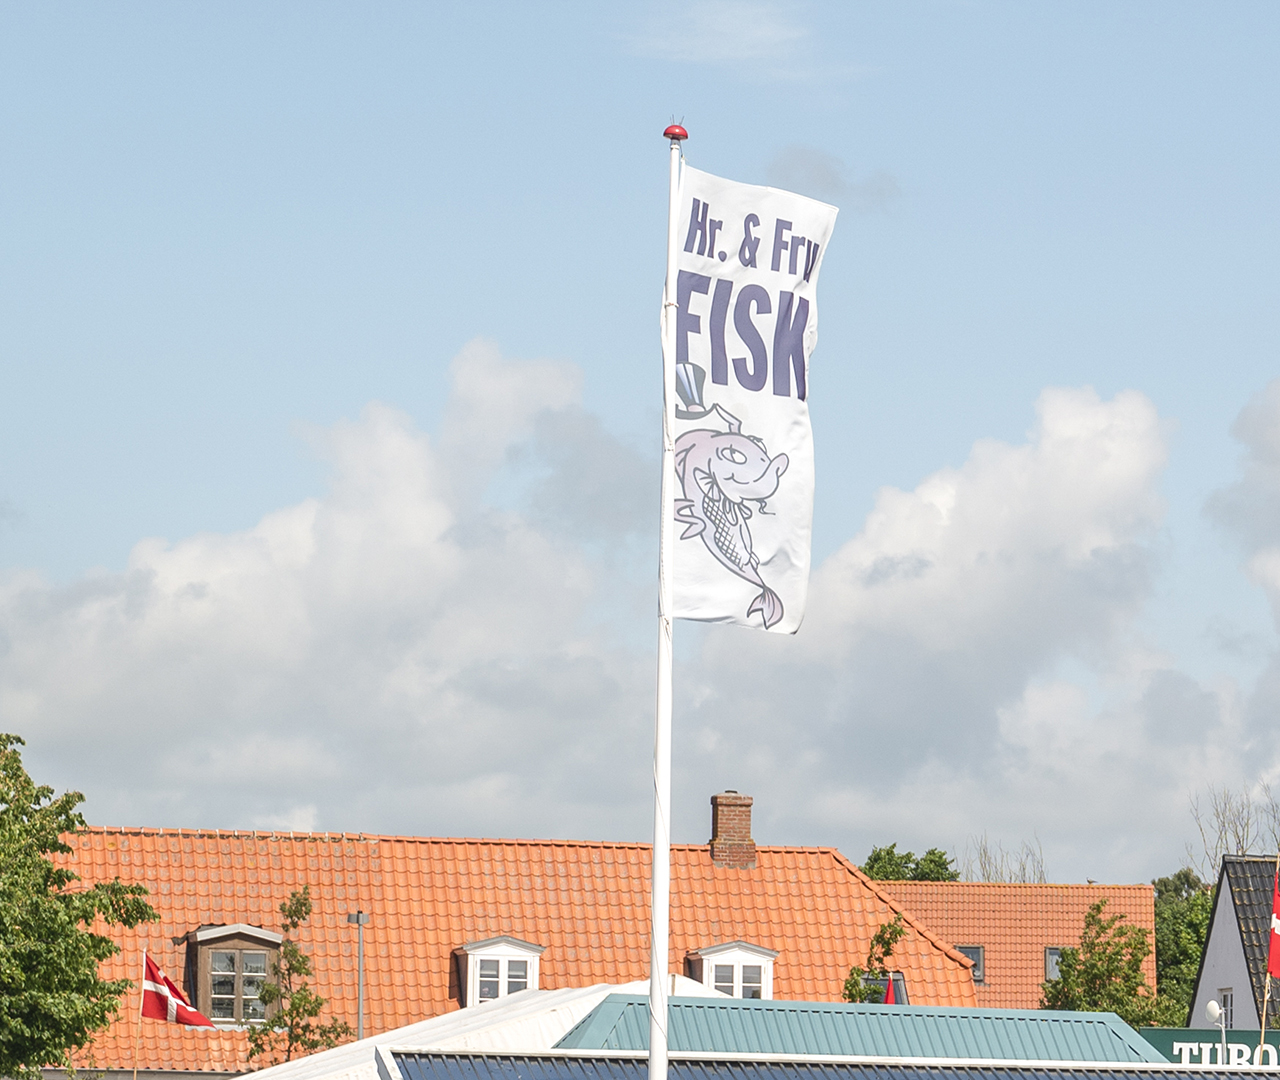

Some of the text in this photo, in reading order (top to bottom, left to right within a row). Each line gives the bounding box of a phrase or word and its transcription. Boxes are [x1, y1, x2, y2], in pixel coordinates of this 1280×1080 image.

[683, 197, 727, 262] Hr.
[738, 213, 761, 268] &
[677, 269, 810, 402] FISK
